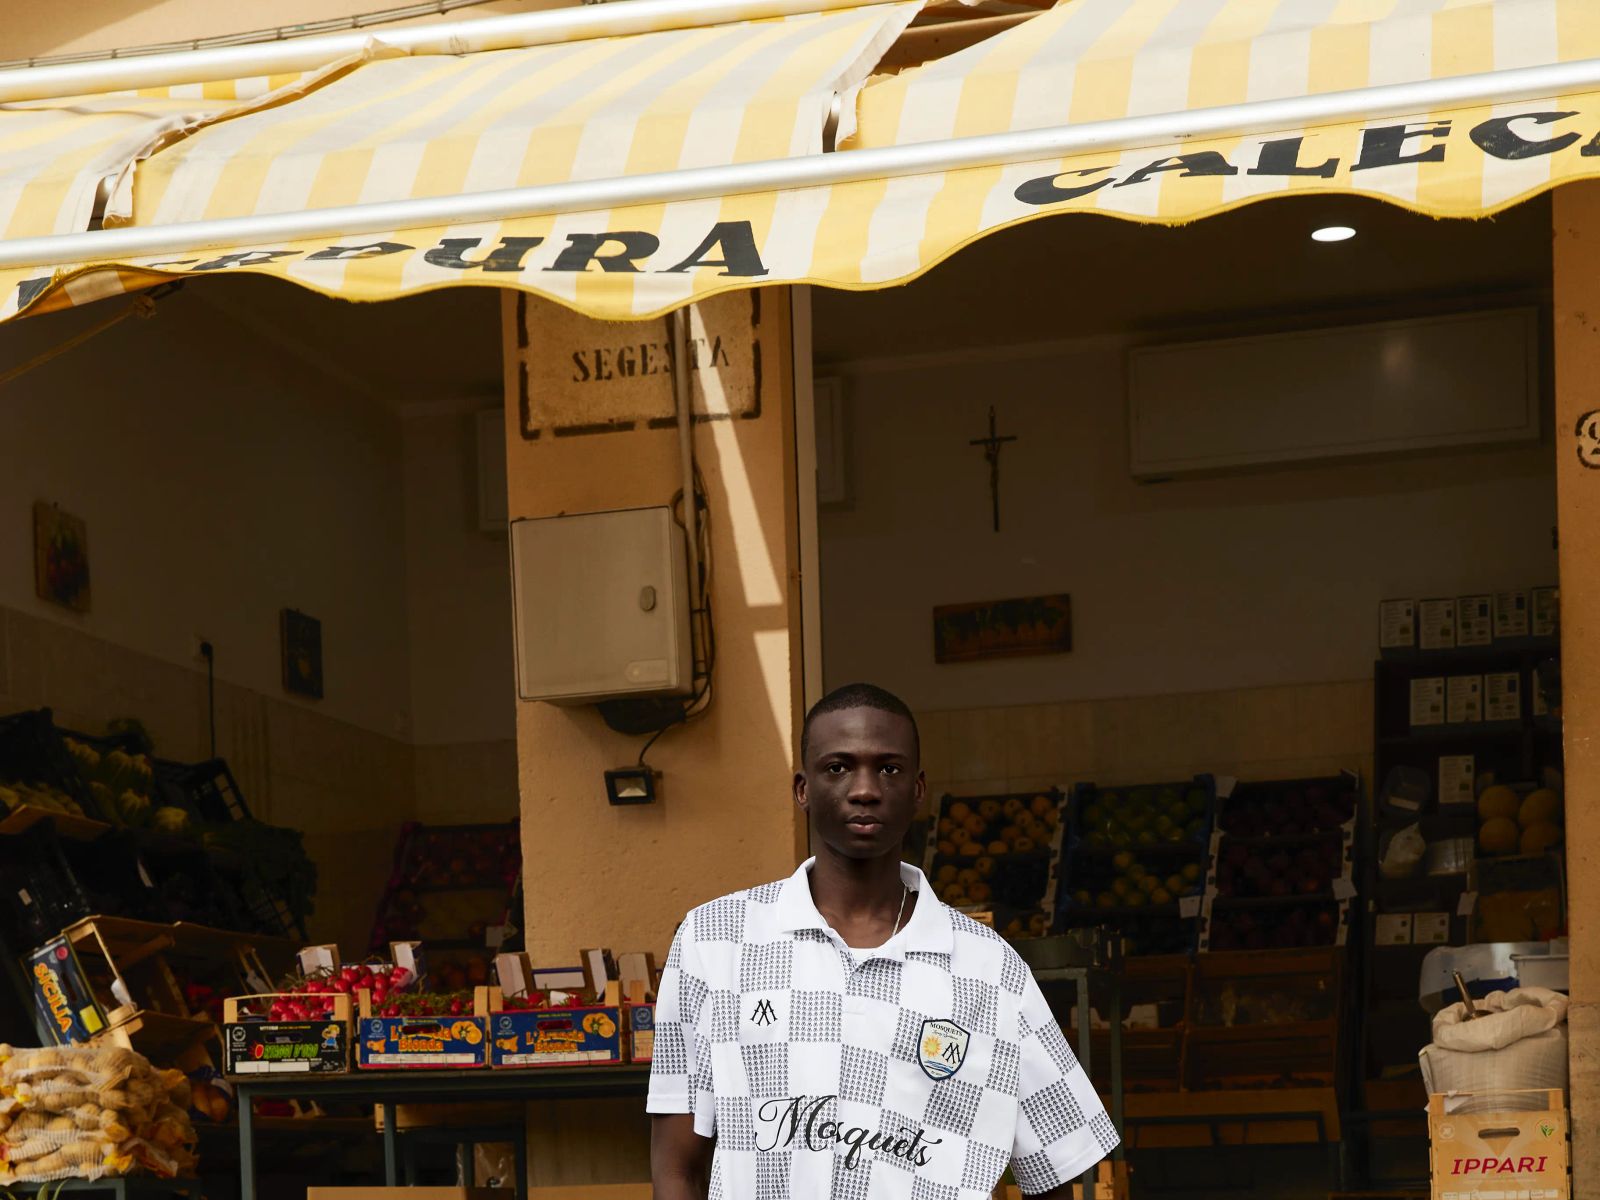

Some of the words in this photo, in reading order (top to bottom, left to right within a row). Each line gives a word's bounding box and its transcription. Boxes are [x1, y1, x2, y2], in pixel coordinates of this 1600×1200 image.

[1014, 111, 1600, 205] CALEC
[33, 962, 73, 1034] SICILIA
[930, 1021, 963, 1037] MOSQUETS
[755, 1095, 944, 1170] Mosquets
[1450, 1156, 1549, 1176] IPPARI
